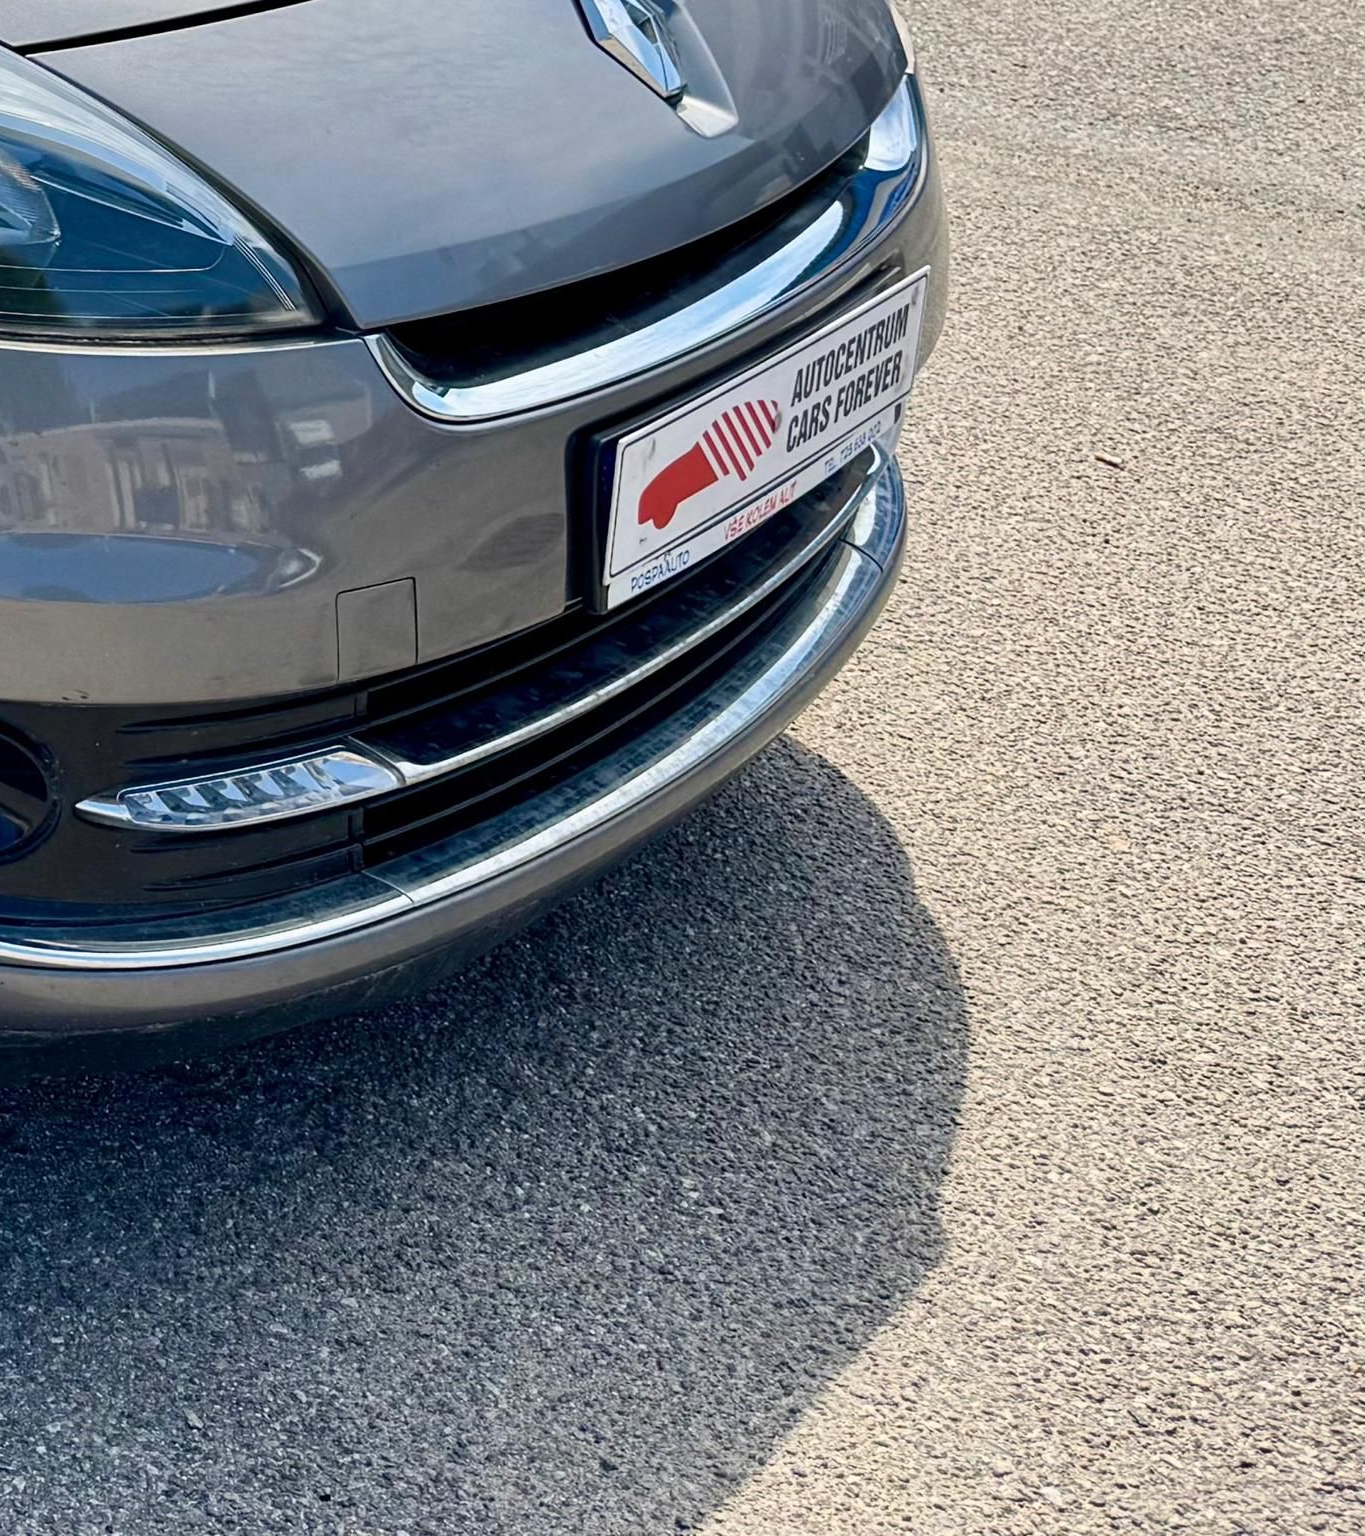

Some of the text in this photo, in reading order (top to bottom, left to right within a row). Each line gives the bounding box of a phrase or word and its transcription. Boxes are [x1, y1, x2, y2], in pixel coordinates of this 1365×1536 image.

[786, 349, 903, 453] CARS FOREVER
[790, 303, 910, 408] AUTOCENTRUM
